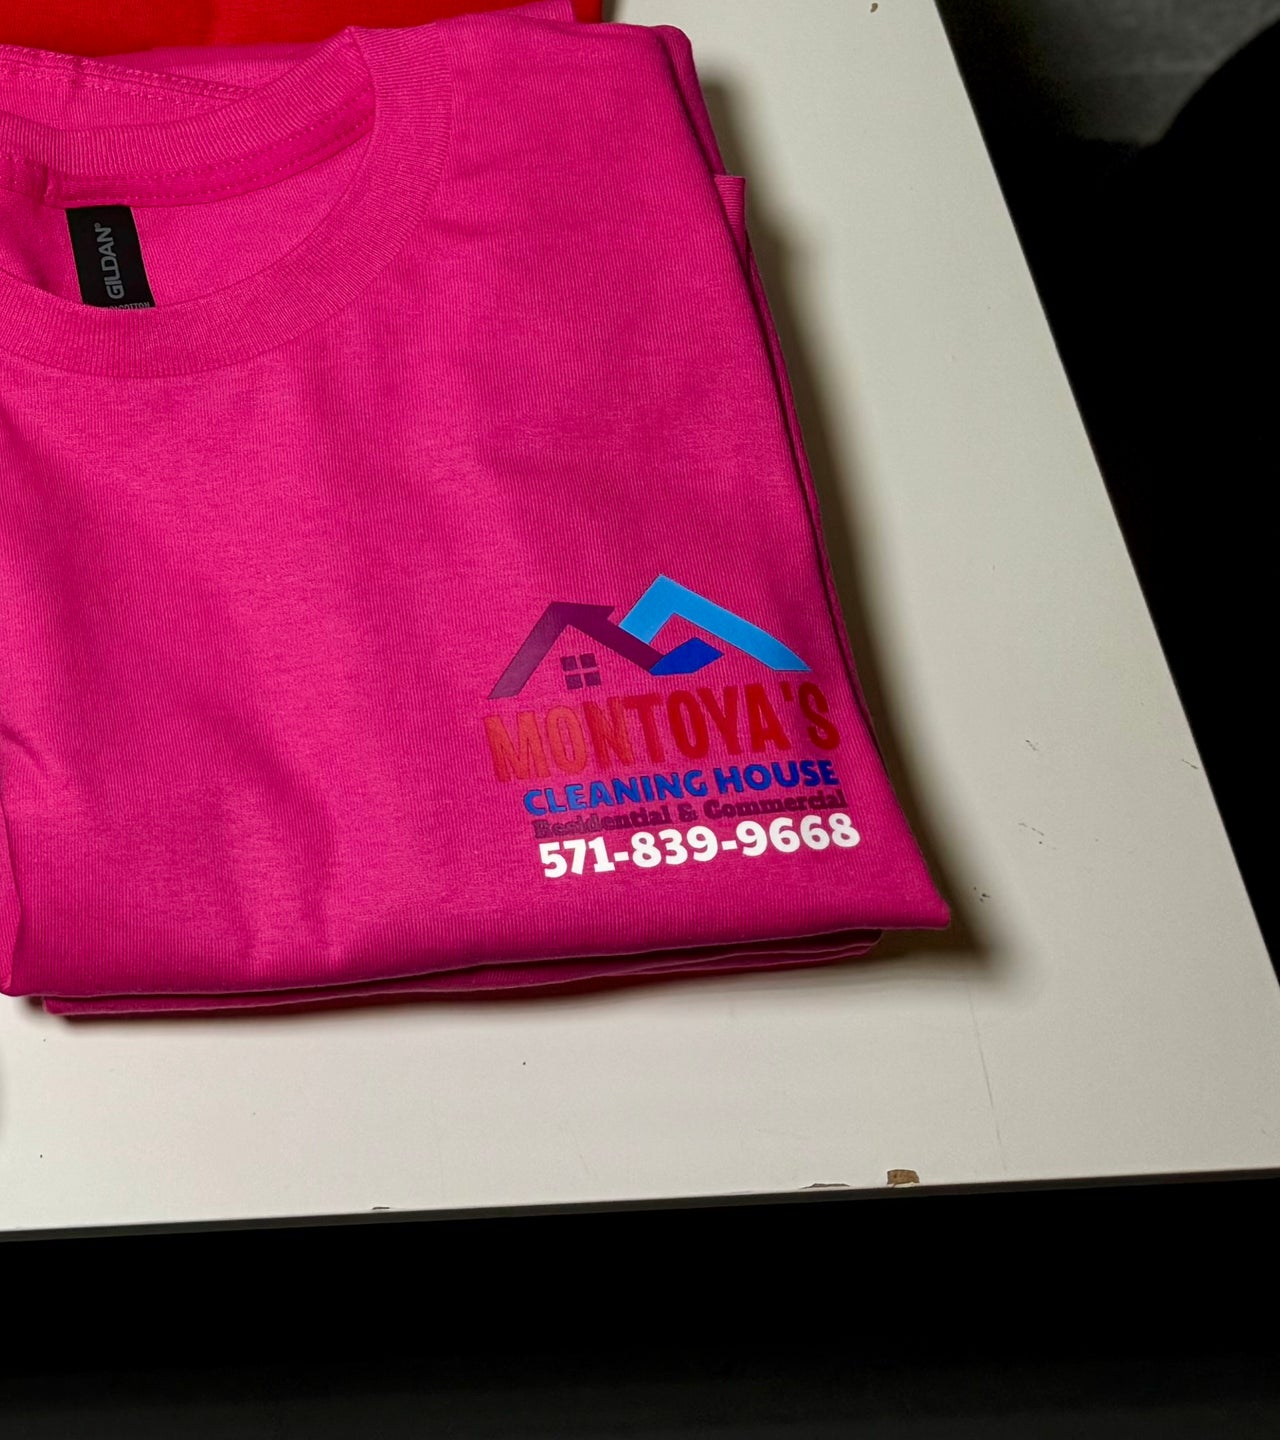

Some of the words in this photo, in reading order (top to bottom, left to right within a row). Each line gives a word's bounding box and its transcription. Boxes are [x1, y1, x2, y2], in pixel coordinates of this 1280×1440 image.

[95, 226, 125, 299] GILDAN
[484, 680, 840, 782] MONTOYA'S
[522, 769, 709, 816] CLEANING
[713, 760, 839, 794] HOUSE
[531, 804, 672, 839] Residential
[678, 804, 698, 823] &
[703, 789, 848, 821] Commercial
[539, 812, 861, 878] 571-839-9668
